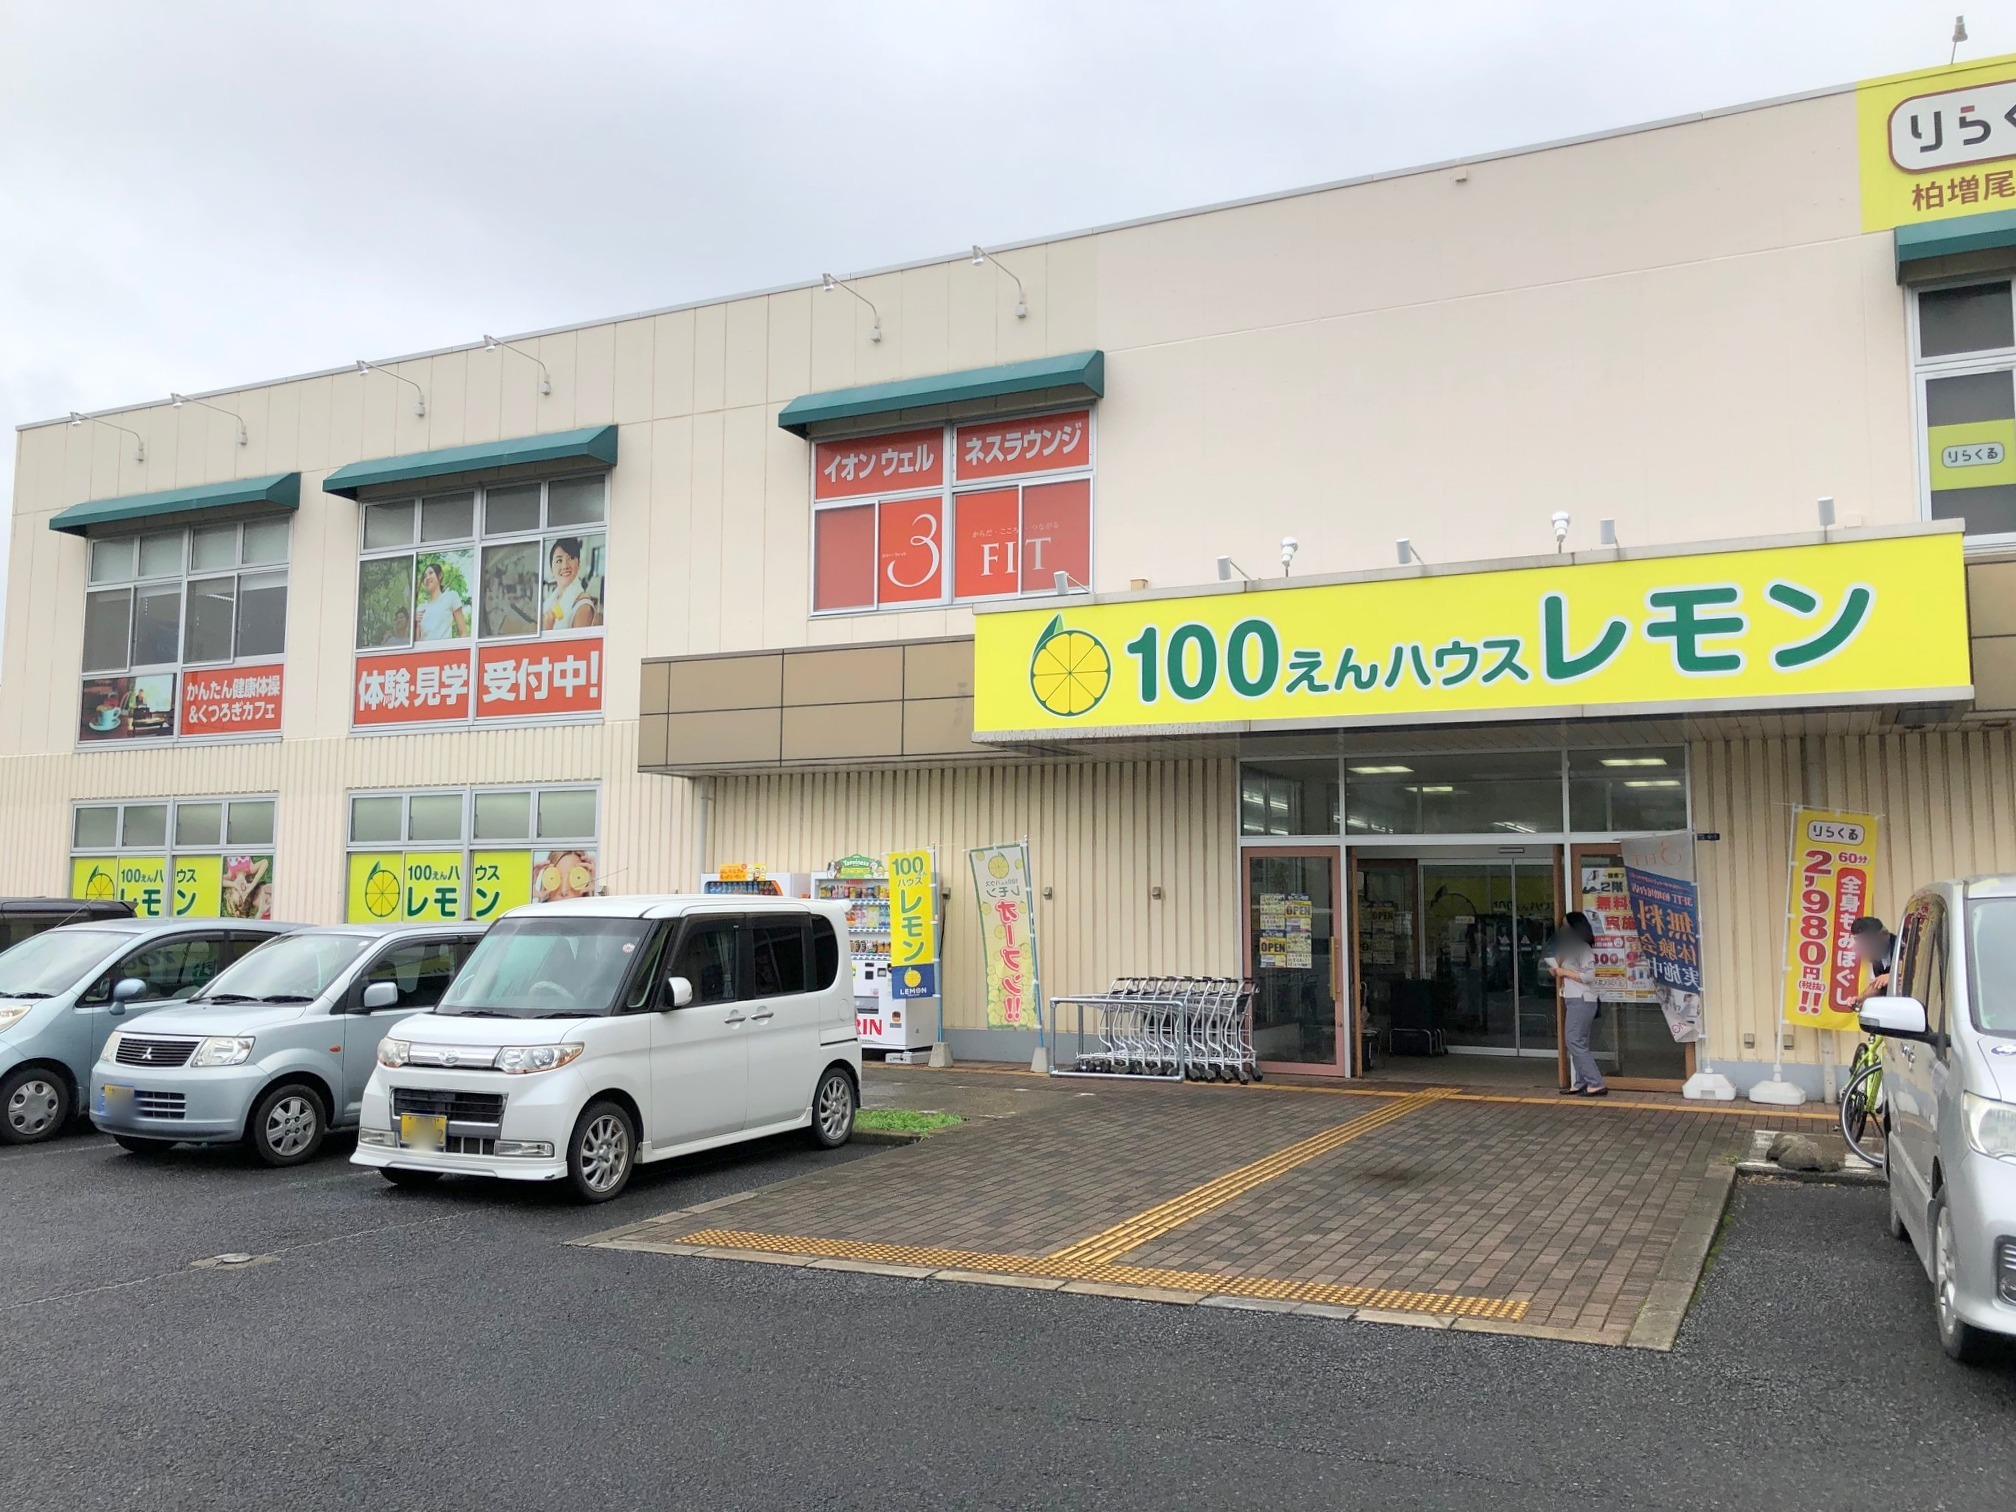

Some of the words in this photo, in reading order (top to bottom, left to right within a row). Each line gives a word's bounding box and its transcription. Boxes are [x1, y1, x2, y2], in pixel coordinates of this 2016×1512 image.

[1948, 447, 1998, 463] りらくる
[980, 537, 1051, 576] FIT
[187, 675, 280, 700] かんたん健康体操
[1813, 825, 1858, 840] りらくる
[1838, 851, 1868, 864] 60分
[1286, 905, 1310, 916] OPEN
[901, 889, 924, 962] レモン
[1261, 942, 1285, 953] OPEN
[900, 987, 927, 996] LEMON
